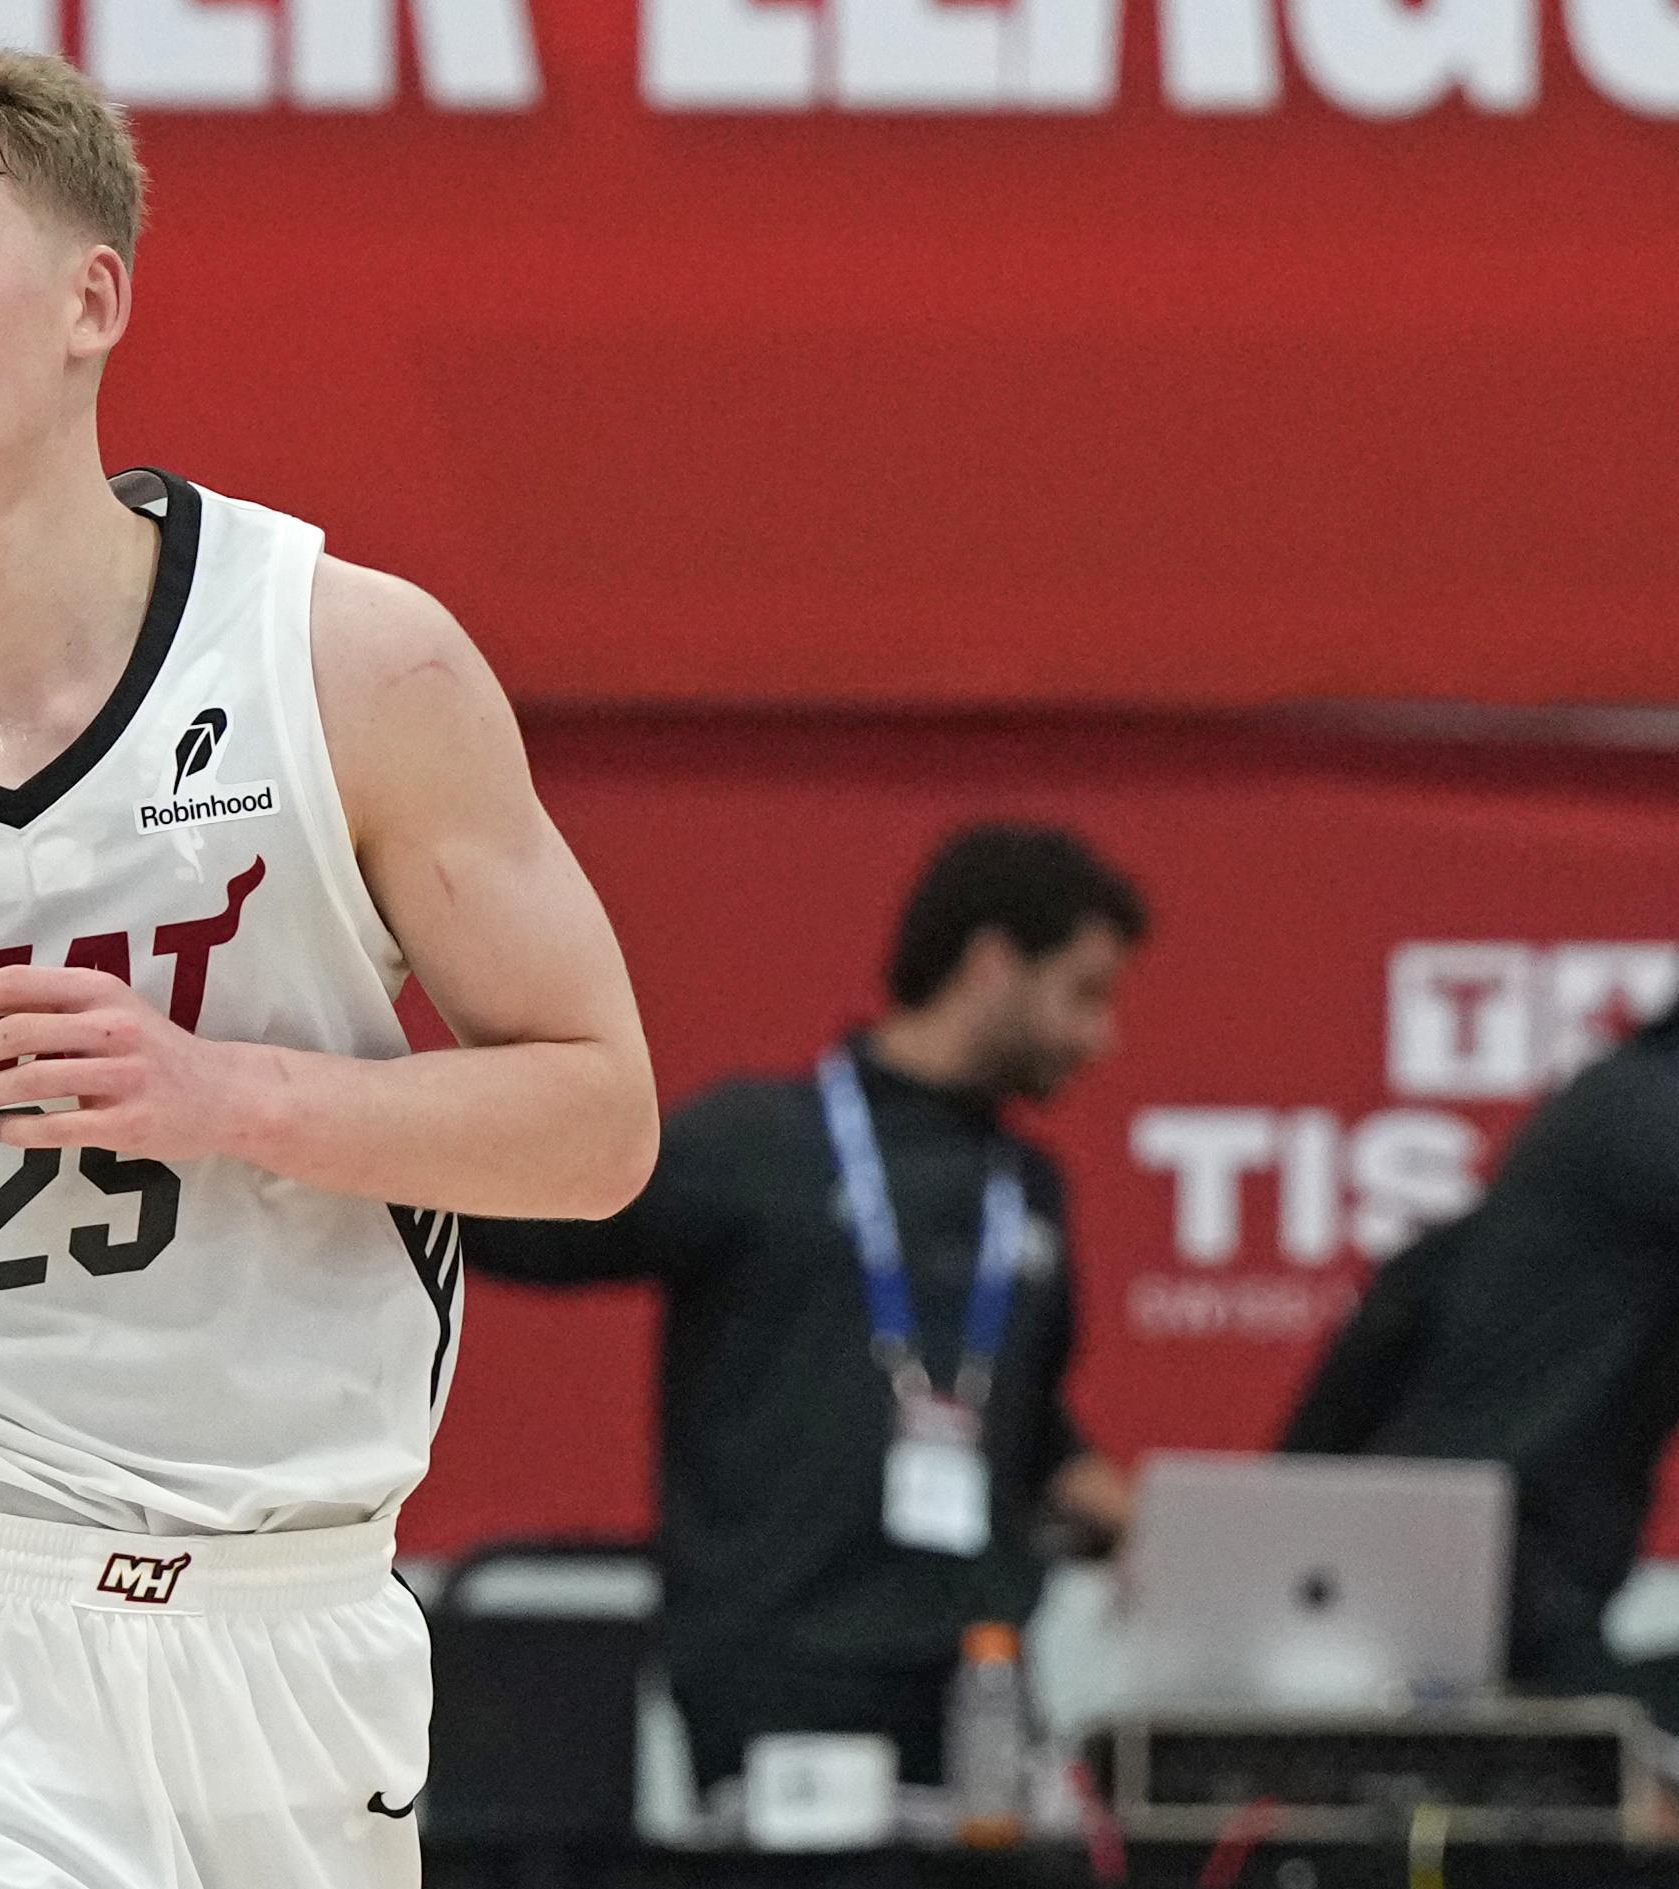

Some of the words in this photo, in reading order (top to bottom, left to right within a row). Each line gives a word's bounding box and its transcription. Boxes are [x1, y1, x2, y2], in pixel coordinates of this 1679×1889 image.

[140, 786, 273, 829] Robinhood
[1129, 1106, 1487, 1268] TIS
[97, 1551, 192, 1604] MH
